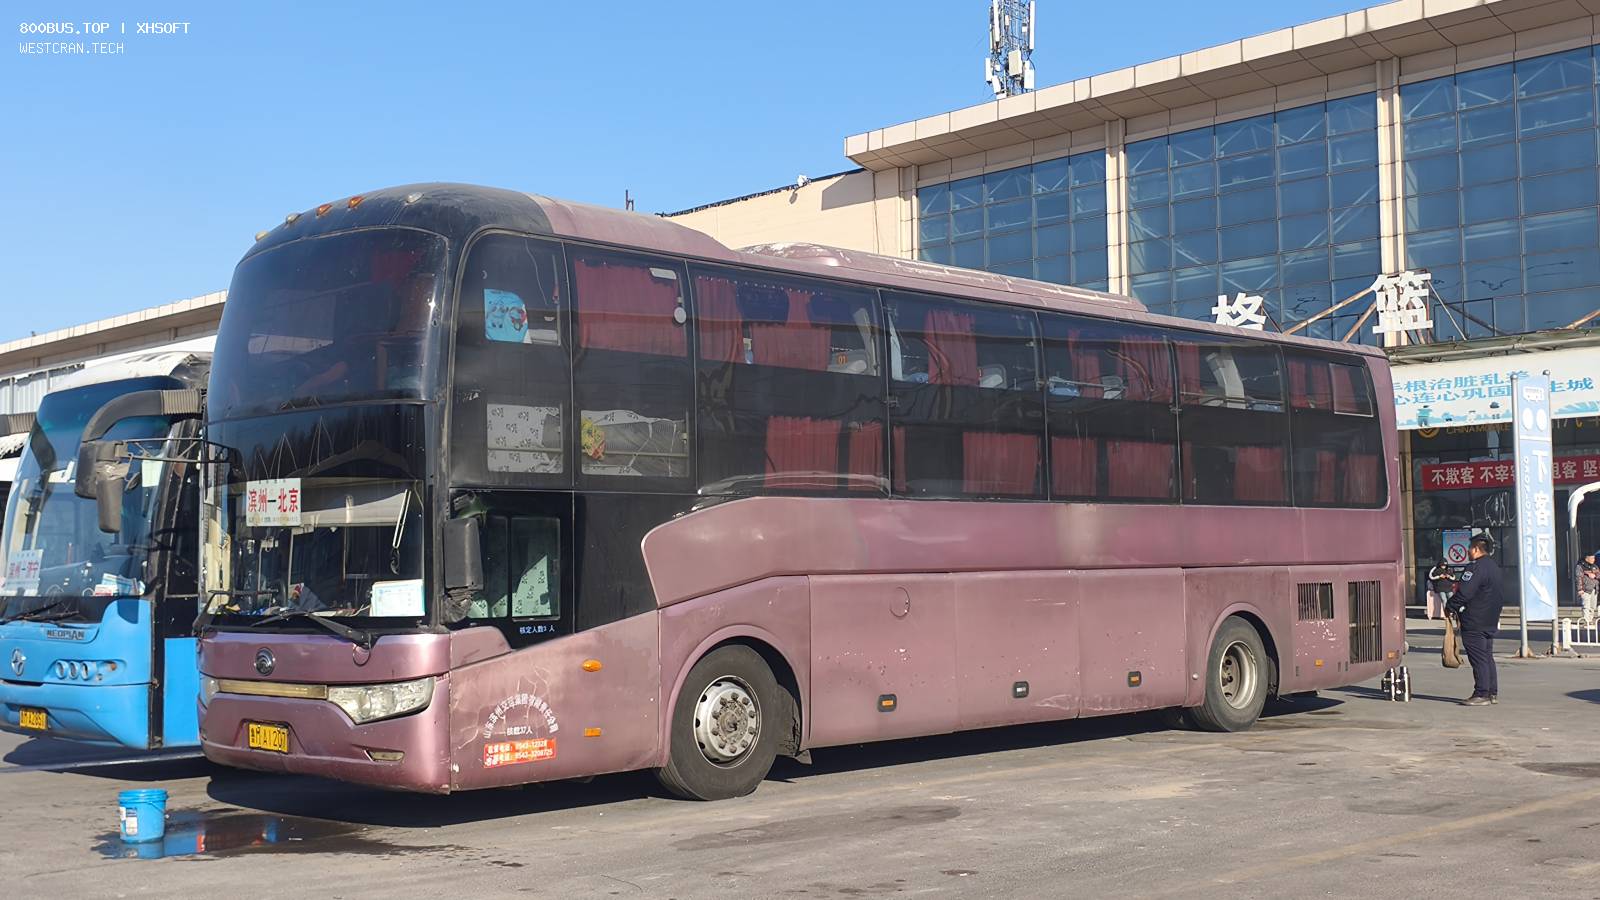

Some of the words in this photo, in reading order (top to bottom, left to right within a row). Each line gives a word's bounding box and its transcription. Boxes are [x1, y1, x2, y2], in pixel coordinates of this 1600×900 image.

[1432, 466, 1475, 486] 不欺客
[1583, 459, 1600, 477] 坚
[1532, 449, 1552, 567] 下客区
